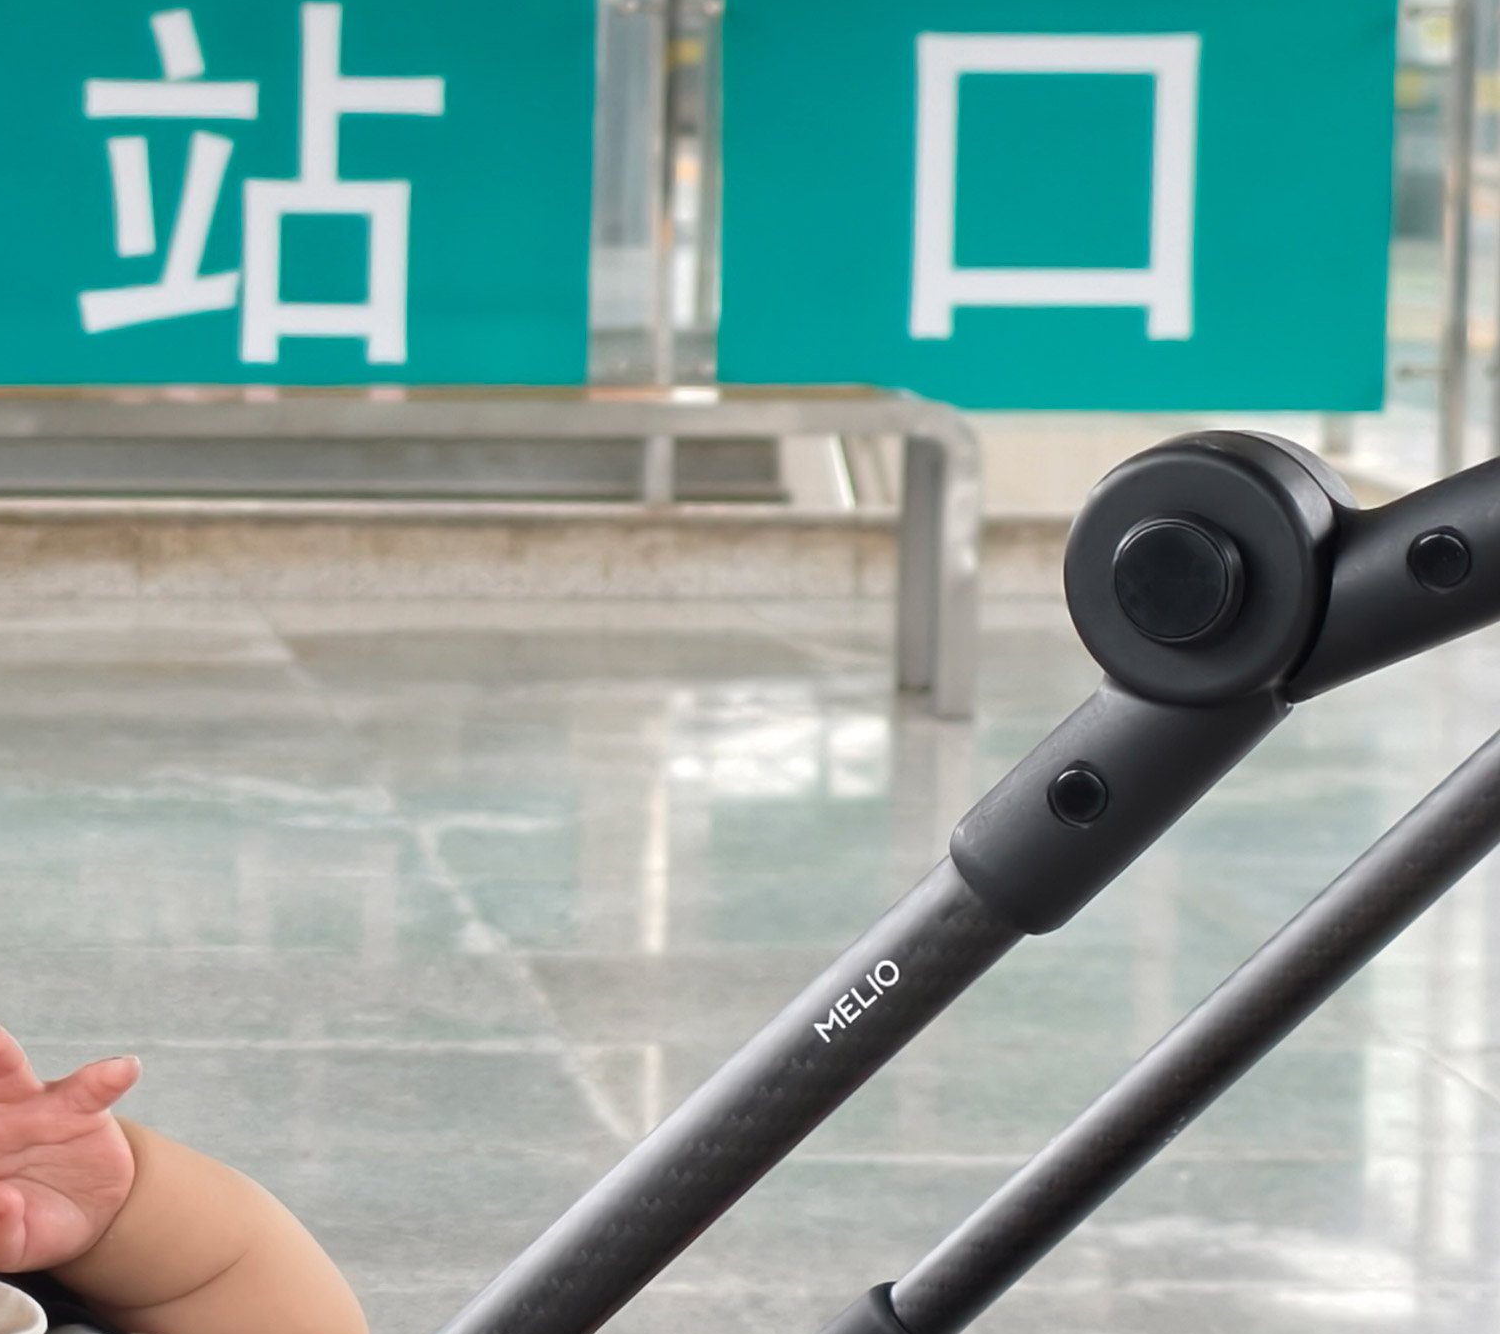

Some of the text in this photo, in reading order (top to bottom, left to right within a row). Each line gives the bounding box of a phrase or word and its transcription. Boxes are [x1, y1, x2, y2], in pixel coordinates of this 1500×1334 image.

[79, 1, 445, 365] 站
[908, 31, 1200, 341] 口
[813, 959, 900, 1044] MELIO
